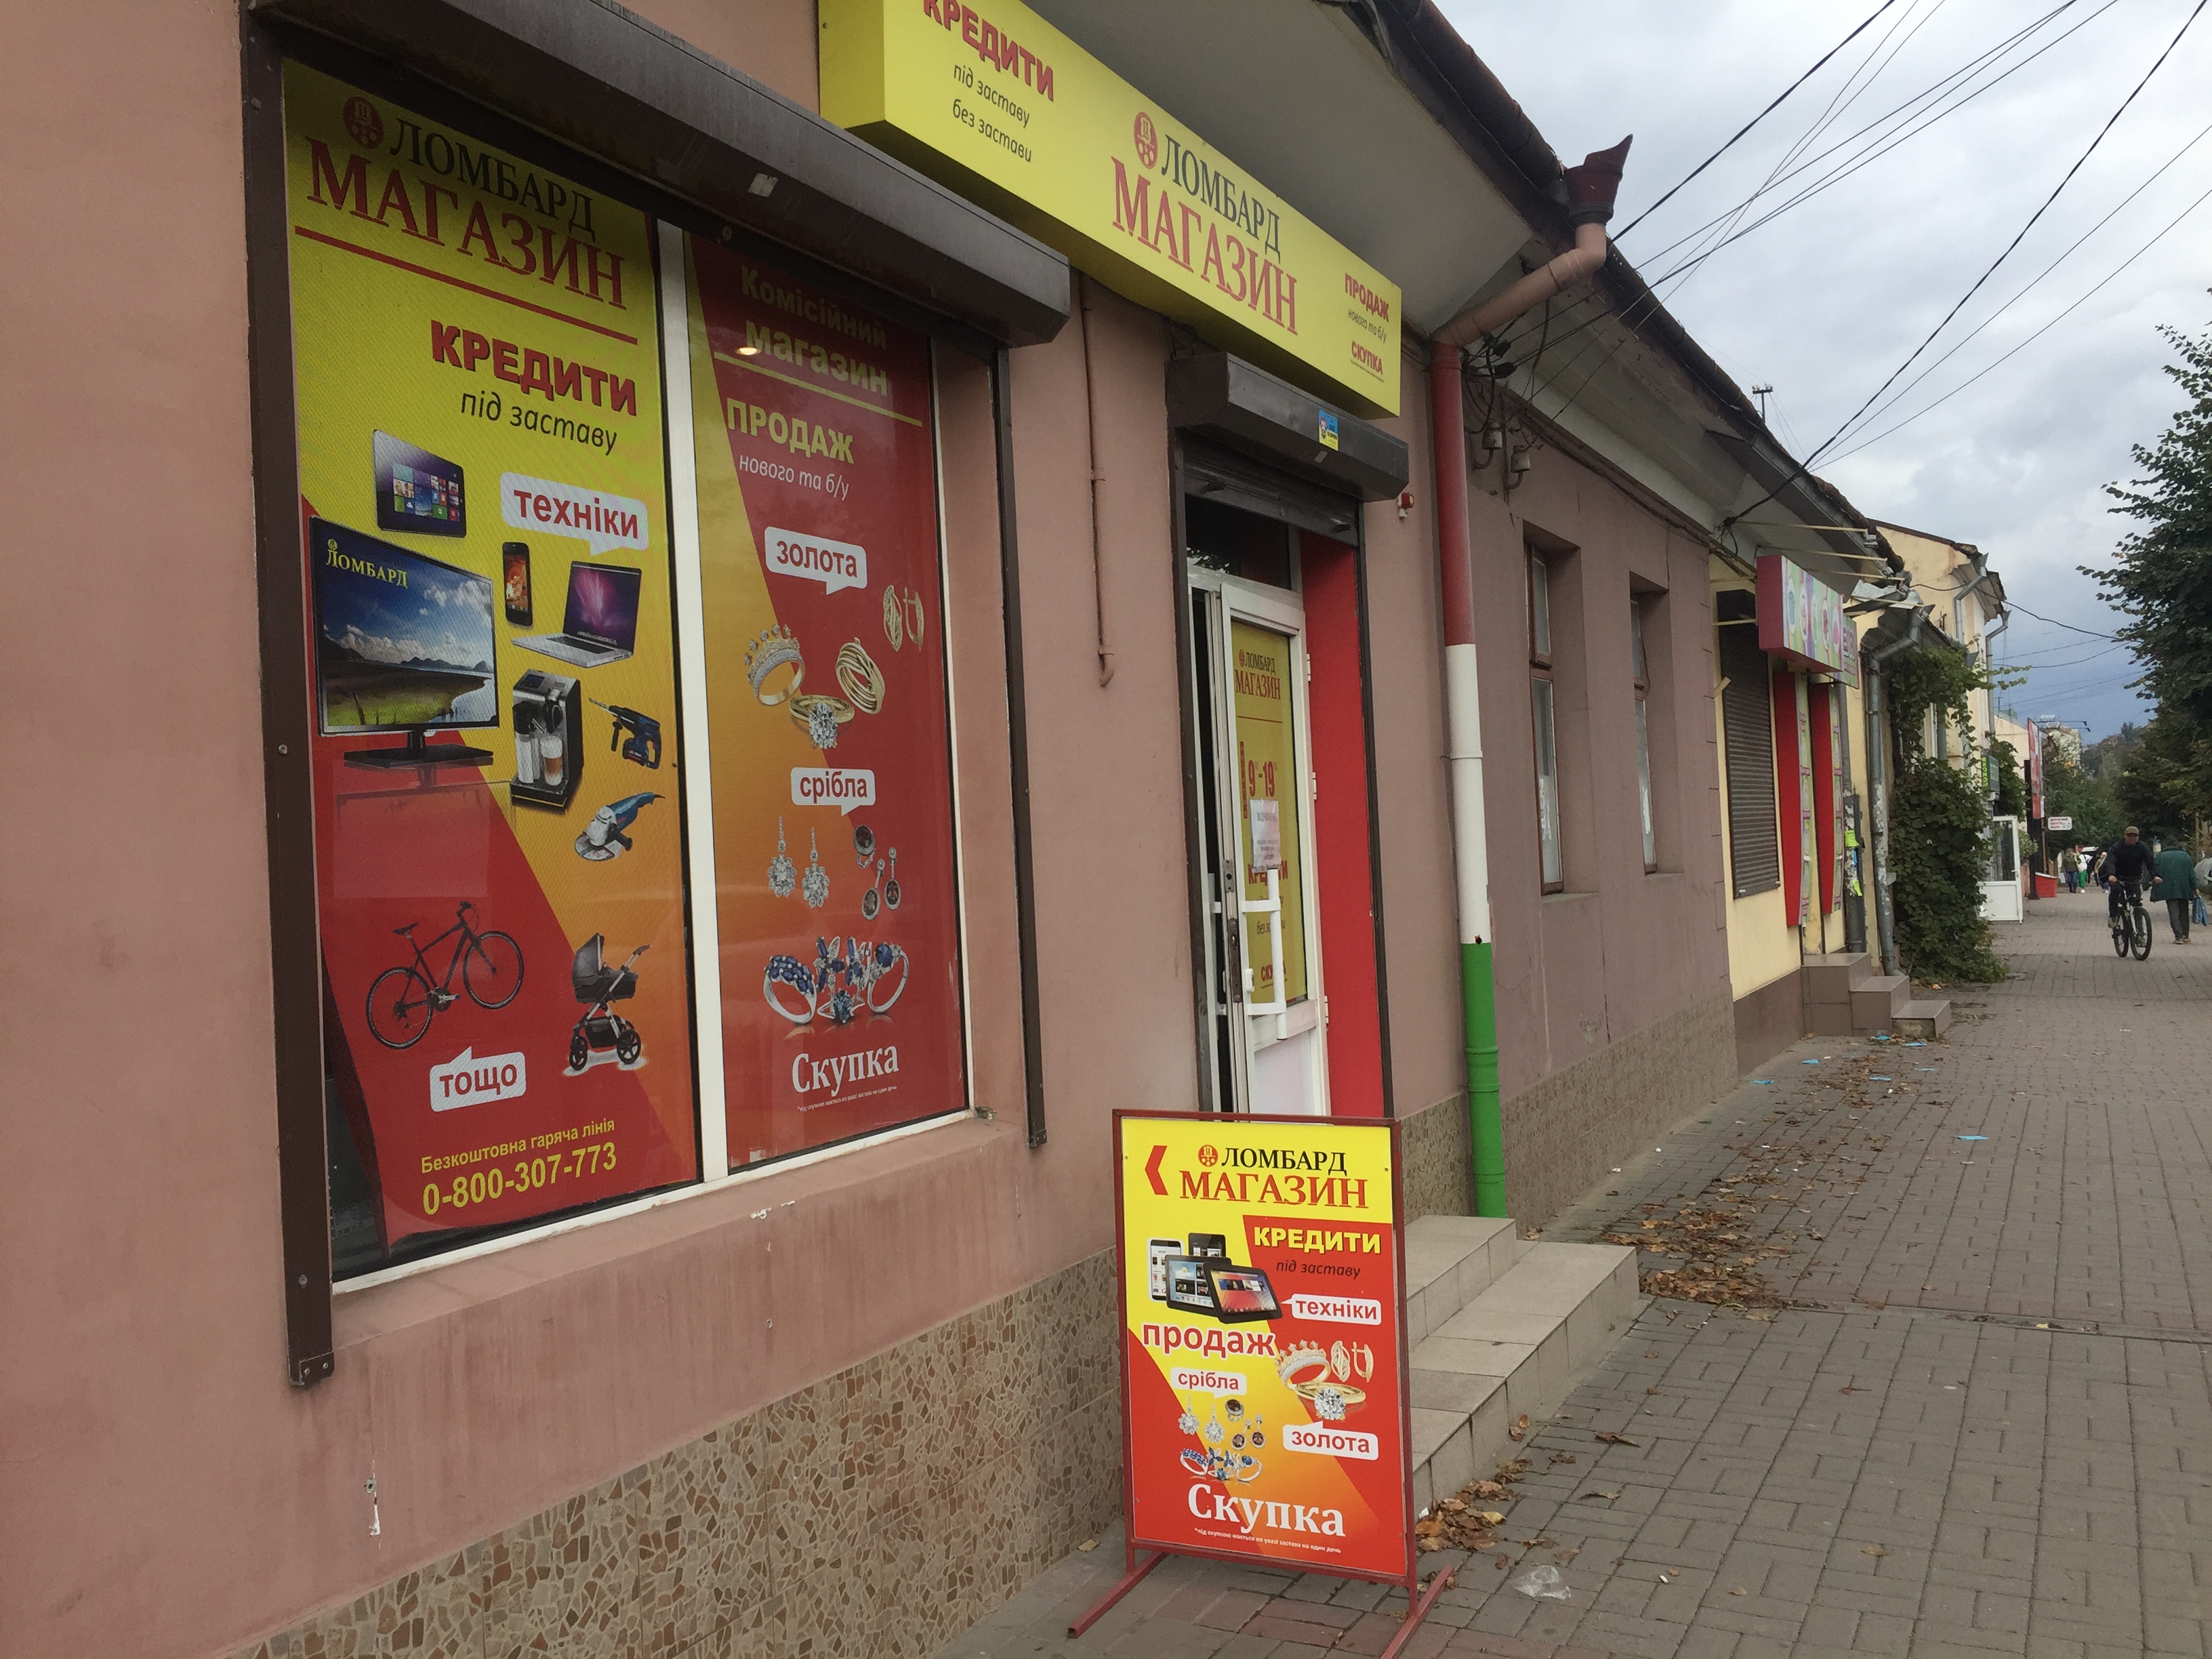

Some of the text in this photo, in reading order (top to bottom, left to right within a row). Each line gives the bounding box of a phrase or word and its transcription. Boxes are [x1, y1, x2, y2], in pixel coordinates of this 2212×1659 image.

[923, 0, 1054, 102] КРЕДИТИ
[954, 64, 1030, 129] під заставу
[953, 98, 1031, 163] без застави
[390, 118, 596, 243] ЛОМБАРД
[1162, 134, 1281, 264] ЛОМБАРД
[306, 137, 627, 310] МАГАЗИН
[1111, 156, 1298, 336] МАГАЗИН
[741, 265, 887, 350] Комісійний
[1345, 272, 1389, 323] ПРОДАЖ
[1349, 309, 1368, 329] нового
[1368, 322, 1377, 335] та
[430, 319, 637, 416] КРЕДИТИ
[746, 320, 888, 396] магазин
[1351, 341, 1383, 375] СКУПКА
[461, 390, 617, 455] під заставу
[726, 397, 855, 464] ПРОДАЖ
[739, 455, 850, 501] нового та б/у
[514, 489, 639, 539] техніки
[325, 548, 408, 588] ЛОМБАРД
[777, 541, 858, 578] золота
[1234, 670, 1282, 700] МАГАЗИН
[1245, 651, 1276, 674] ЛОМБАРД
[800, 771, 868, 801] срібла
[439, 1063, 518, 1097] тощо
[792, 1046, 900, 1097] Скупка
[421, 1118, 615, 1174] Безкоштовна гаряча лінія
[1221, 1147, 1347, 1176] ЛОМБАРД
[423, 1142, 617, 1215] 0-800-307-773
[1179, 1170, 1369, 1209] МАГАЗИН
[1253, 1227, 1381, 1254] КРЕДИТИ
[1275, 1259, 1361, 1280] під заставу
[1296, 1298, 1377, 1320] техніки
[1143, 1324, 1275, 1358] продаж
[1178, 1371, 1240, 1391] срібла
[1291, 1431, 1370, 1453] золота
[1187, 1483, 1347, 1537] Скупка
